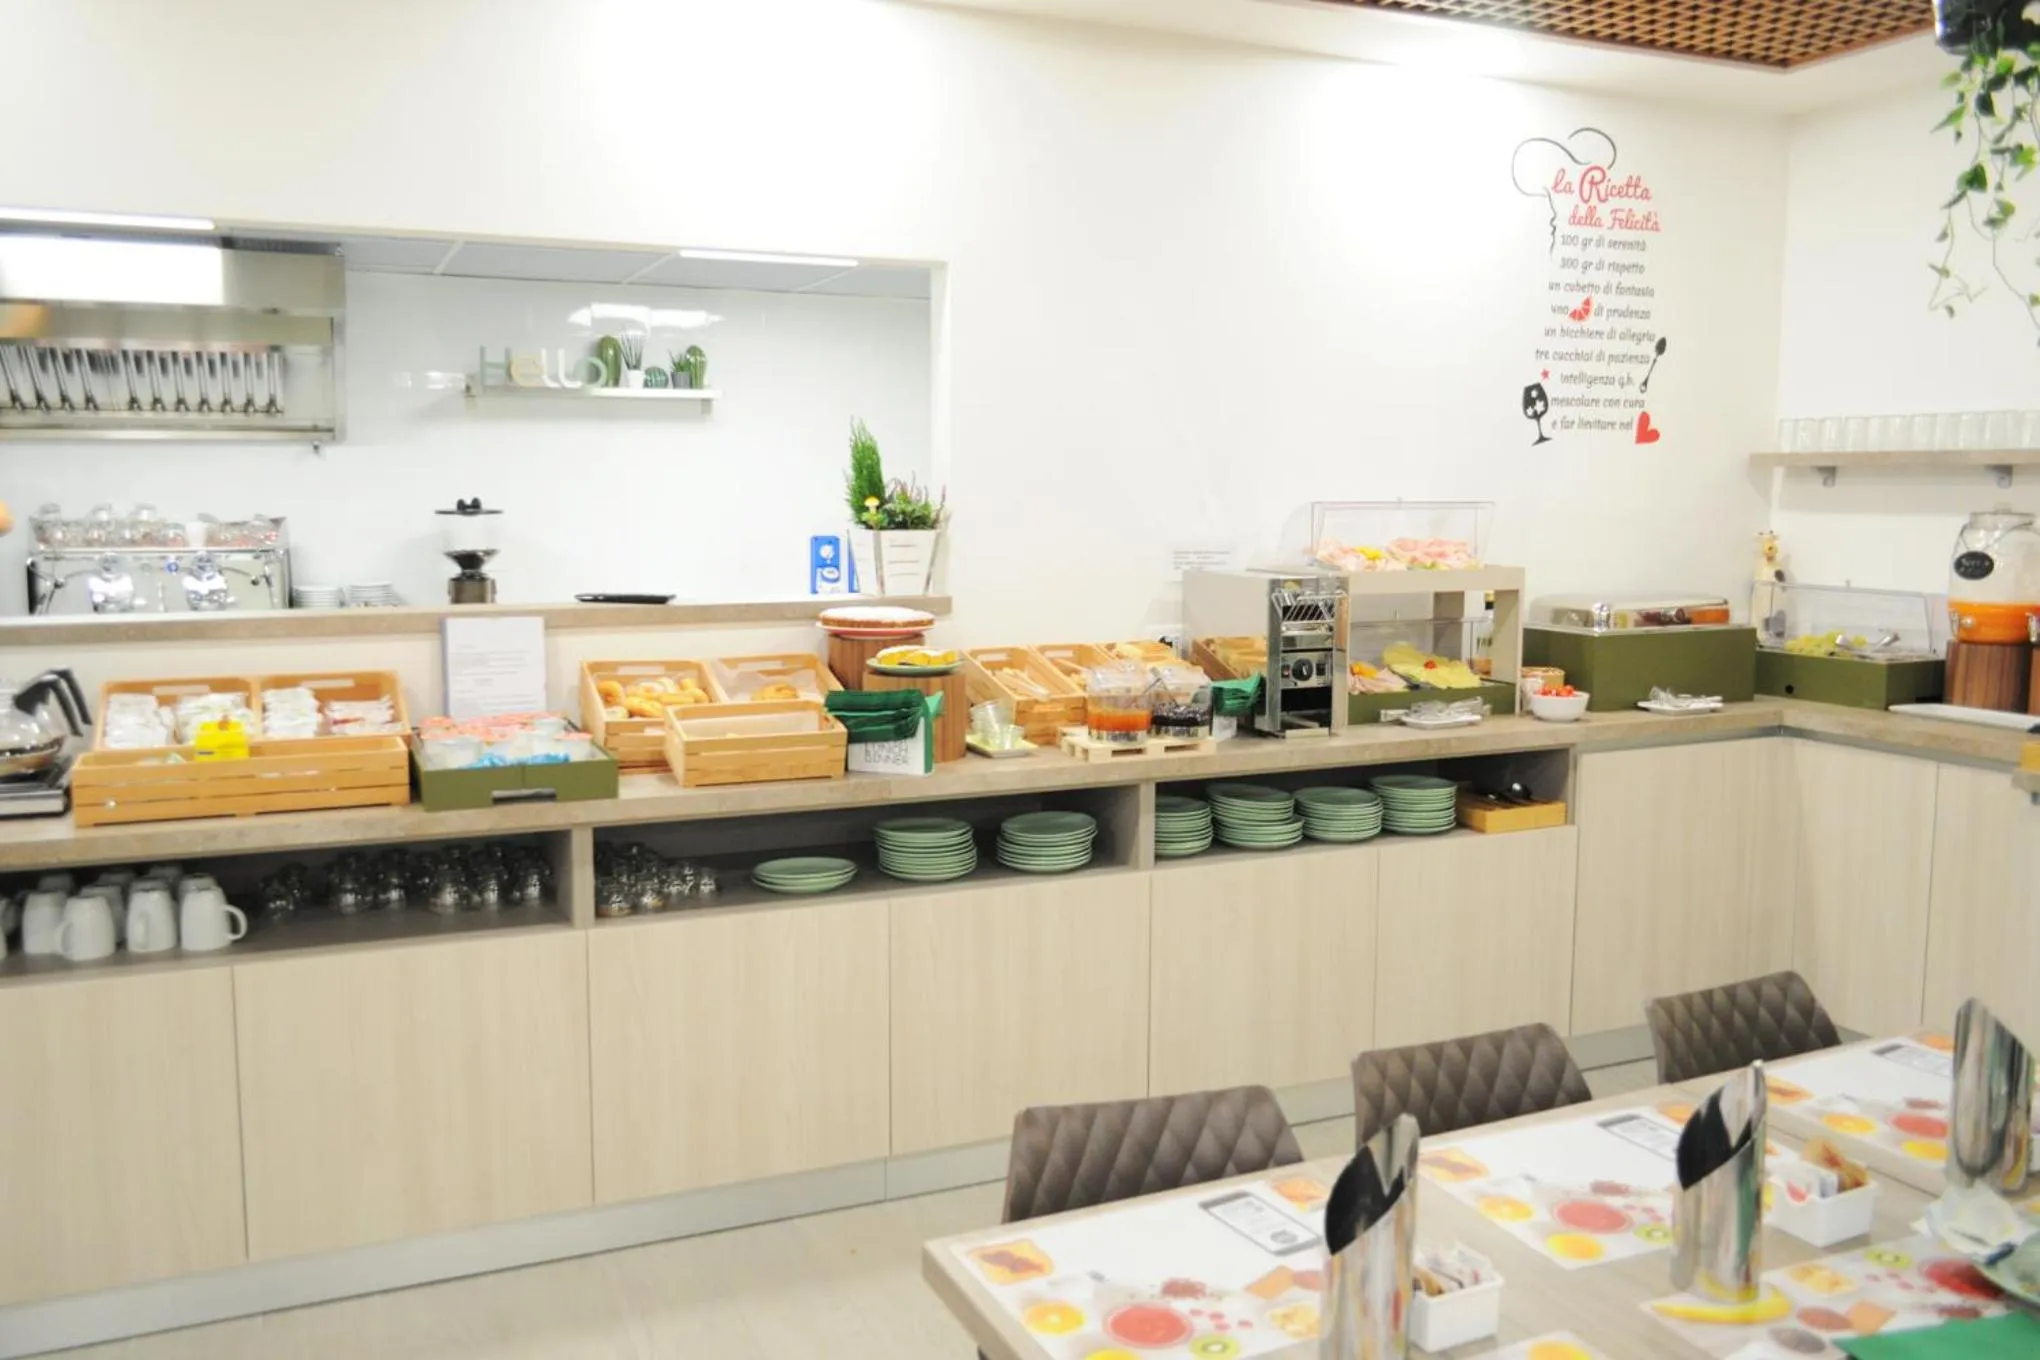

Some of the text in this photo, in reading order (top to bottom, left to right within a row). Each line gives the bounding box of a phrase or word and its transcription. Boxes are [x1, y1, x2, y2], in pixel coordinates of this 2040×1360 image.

[1552, 165, 1651, 203] la Ricetta
[1568, 204, 1603, 227] della
[1561, 234, 1579, 246] 100
[1581, 237, 1594, 252] gr
[1595, 234, 1605, 248] di
[1581, 260, 1594, 275] gr
[1595, 258, 1605, 272] di
[1607, 260, 1645, 277] rispetto
[1549, 281, 1655, 298] un cubetto di fantasia
[1594, 304, 1604, 318] di
[1606, 304, 1651, 322] prudenza
[1544, 327, 1556, 337] un
[1560, 325, 1605, 340] bicchiere
[1607, 326, 1617, 341] di
[1535, 348, 1650, 368] tre cucchiai di pazienza
[1551, 395, 1600, 409] mescolare
[1603, 399, 1620, 409] con
[1560, 416, 1575, 430] far
[1620, 417, 1633, 431] nel
